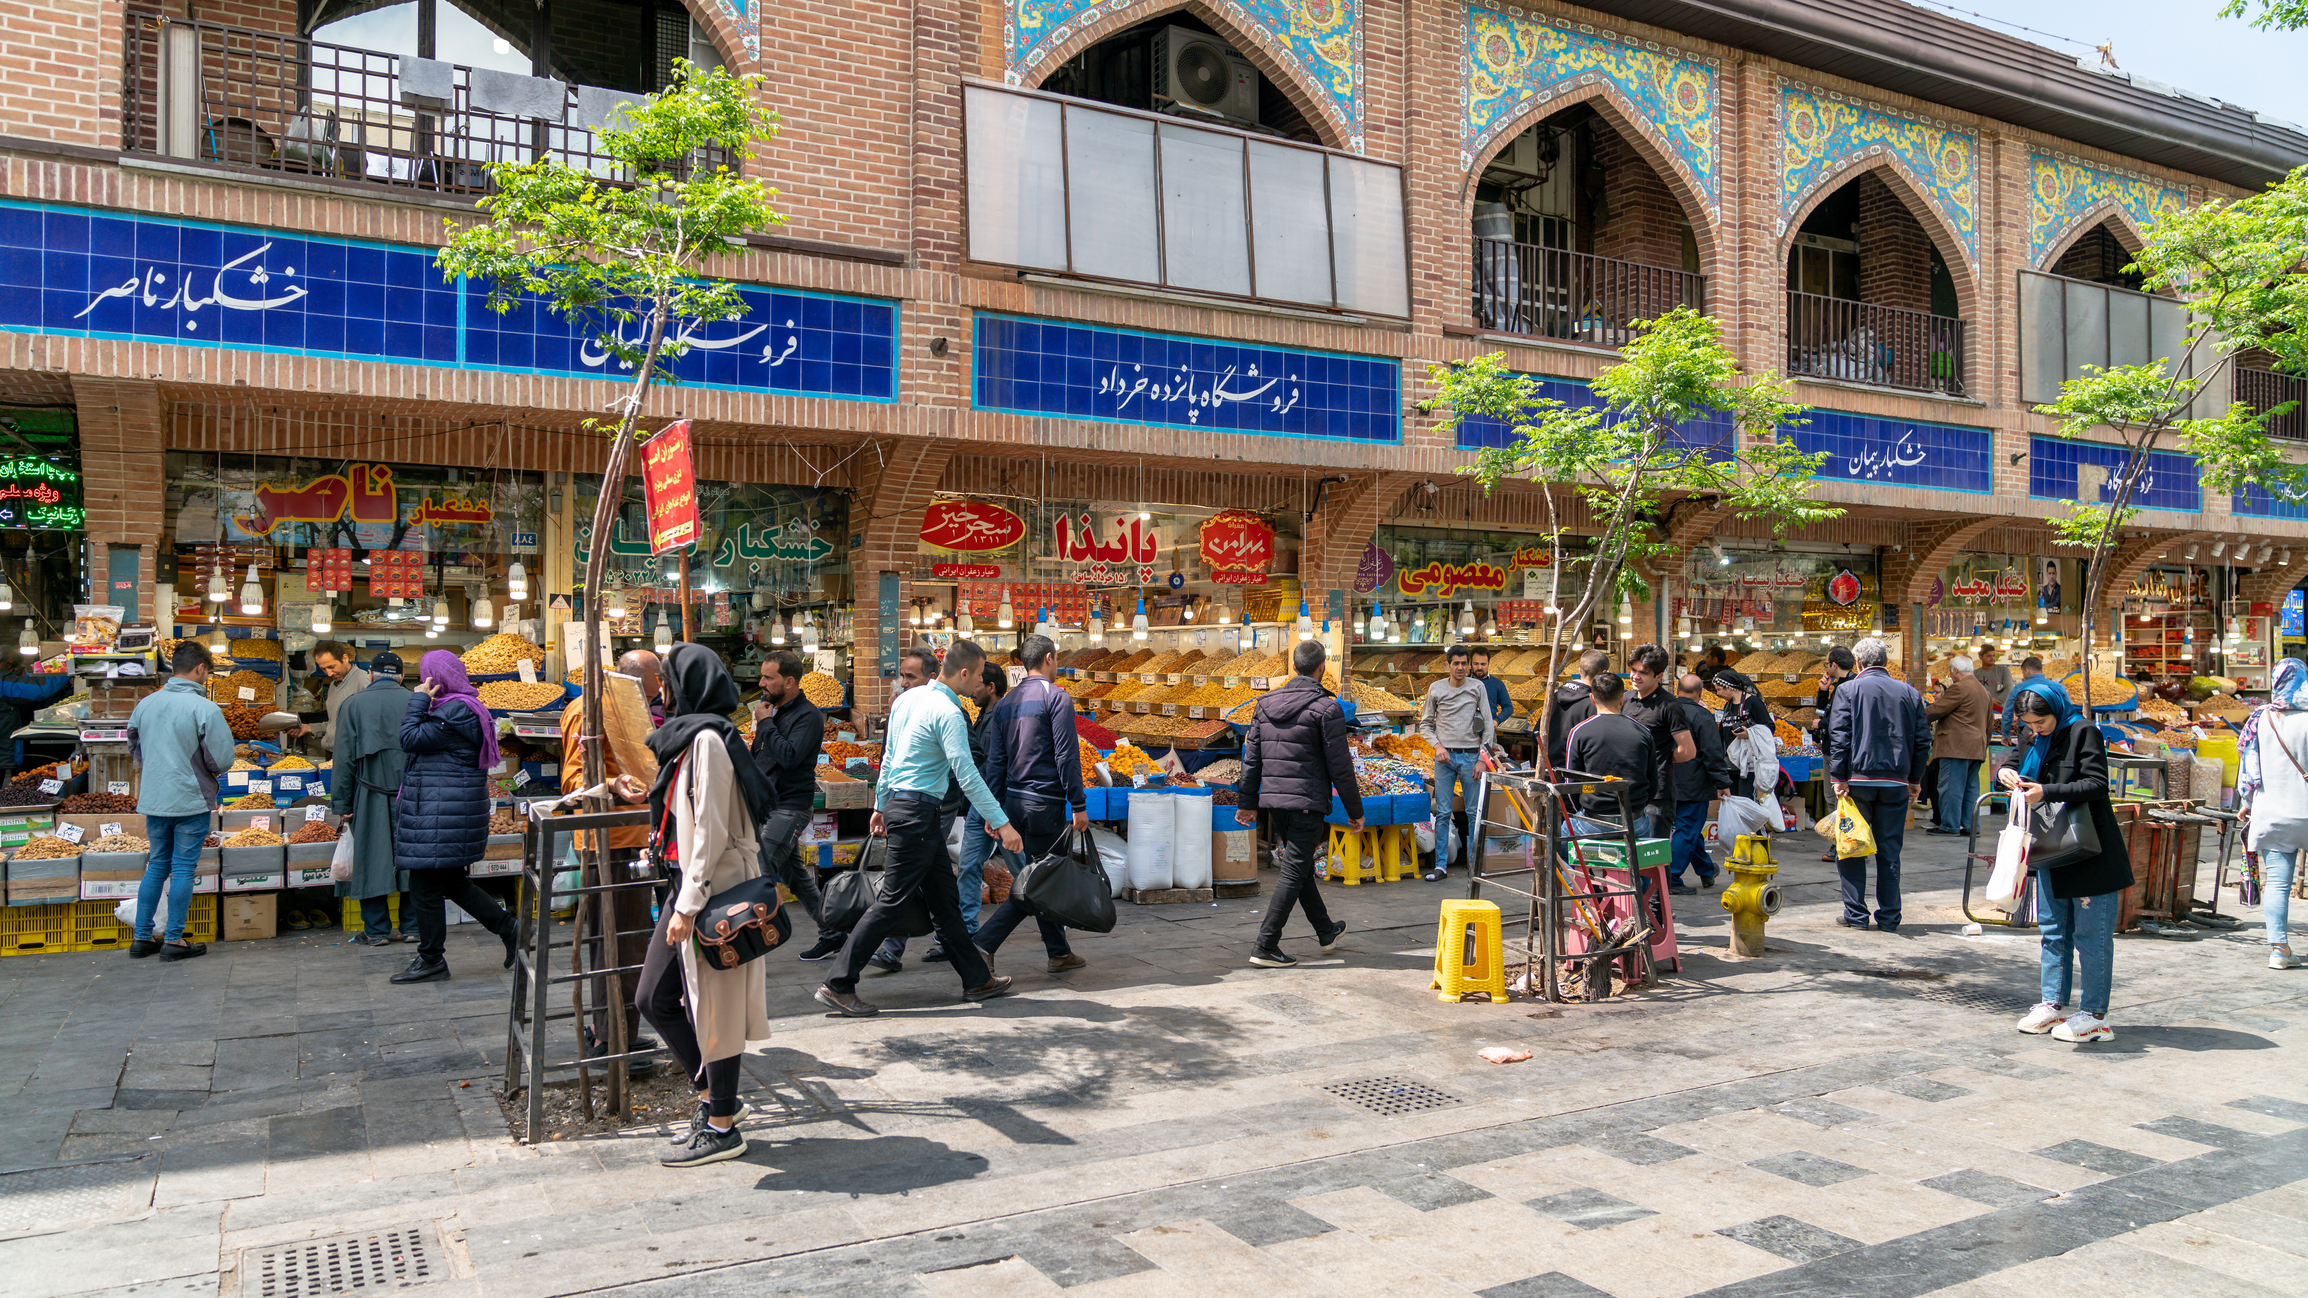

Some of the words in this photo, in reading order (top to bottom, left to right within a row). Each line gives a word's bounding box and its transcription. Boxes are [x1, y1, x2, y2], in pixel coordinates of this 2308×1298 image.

[74, 266, 166, 319] ناصر
[160, 241, 309, 331] خشکبار
[1098, 363, 1149, 411] خرداد
[1150, 364, 1199, 424] پانزده
[1200, 363, 1300, 415] فروشگاه
[1879, 428, 1927, 478] خشکبار
[233, 463, 397, 537] ناصر
[408, 497, 495, 528] خشکبار
[713, 517, 834, 573] خشکبار
[1508, 546, 1555, 573] خشکبار
[1398, 561, 1506, 598] معصومی
[1951, 575, 1990, 604] مجید
[0, 818, 26, 826] aisins
